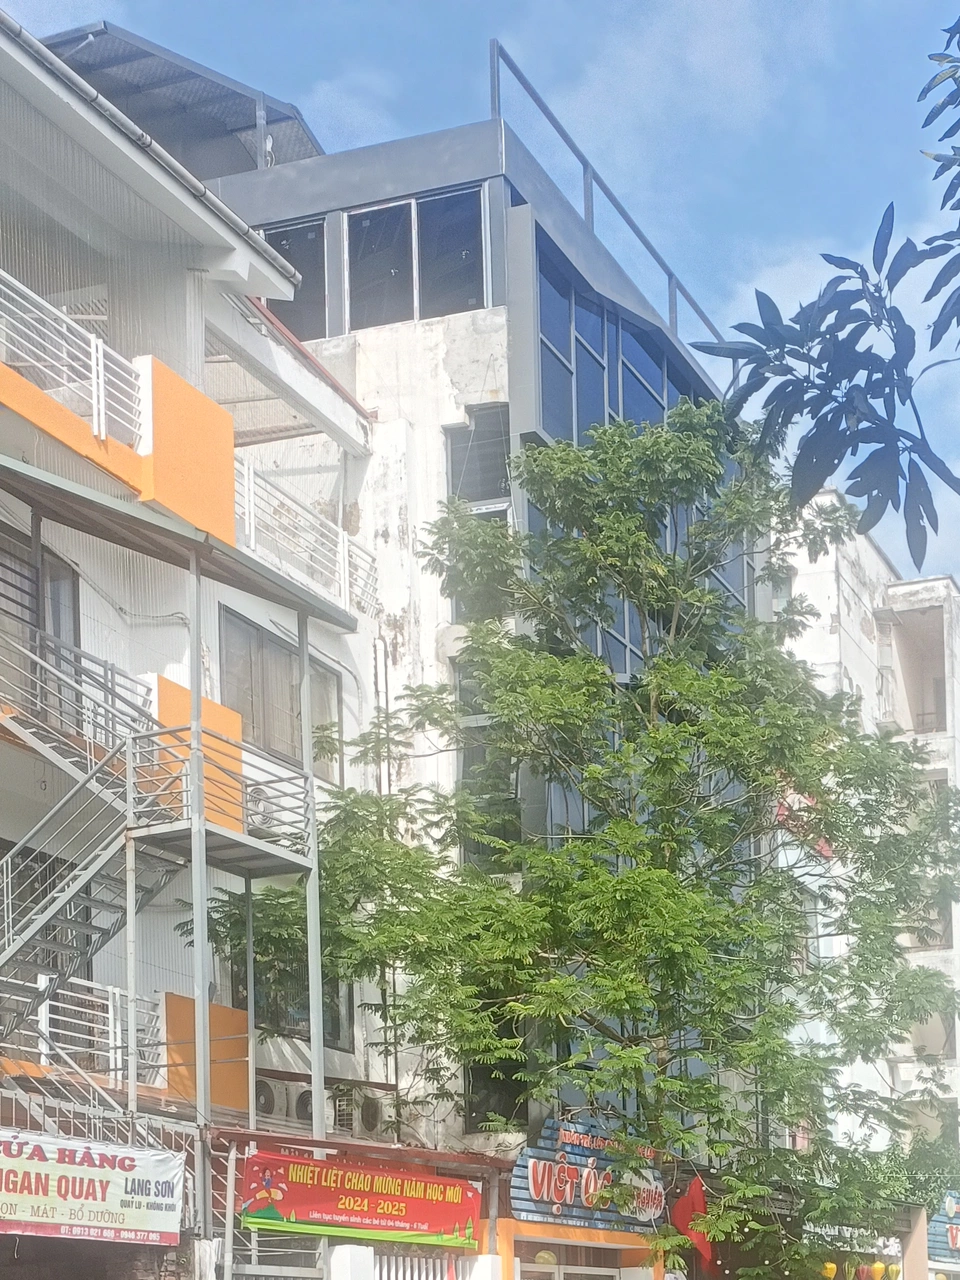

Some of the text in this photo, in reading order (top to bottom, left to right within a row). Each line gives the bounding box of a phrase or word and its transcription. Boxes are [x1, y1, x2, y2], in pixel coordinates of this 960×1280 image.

[56, 1146, 137, 1172] HÀNG
[0, 1169, 110, 1202] GAN QUAY
[124, 1177, 175, 1199] LẠNG SƠN
[288, 1163, 320, 1189] NHIỆT
[321, 1167, 344, 1192] LIỆT
[344, 1170, 372, 1192] CHÀO
[373, 1173, 402, 1196] MỪNG
[403, 1177, 425, 1199] NĂM
[426, 1183, 444, 1204] HỌC
[445, 1184, 463, 1204] MỚI
[528, 1151, 580, 1215] VIỆT
[30, 1204, 57, 1219] MÁT
[69, 1204, 84, 1222] BỔ
[87, 1207, 126, 1225] DƯỠNG
[120, 1199, 135, 1209] QUAY
[337, 1195, 369, 1212] 2024
[376, 1199, 407, 1216] 2025
